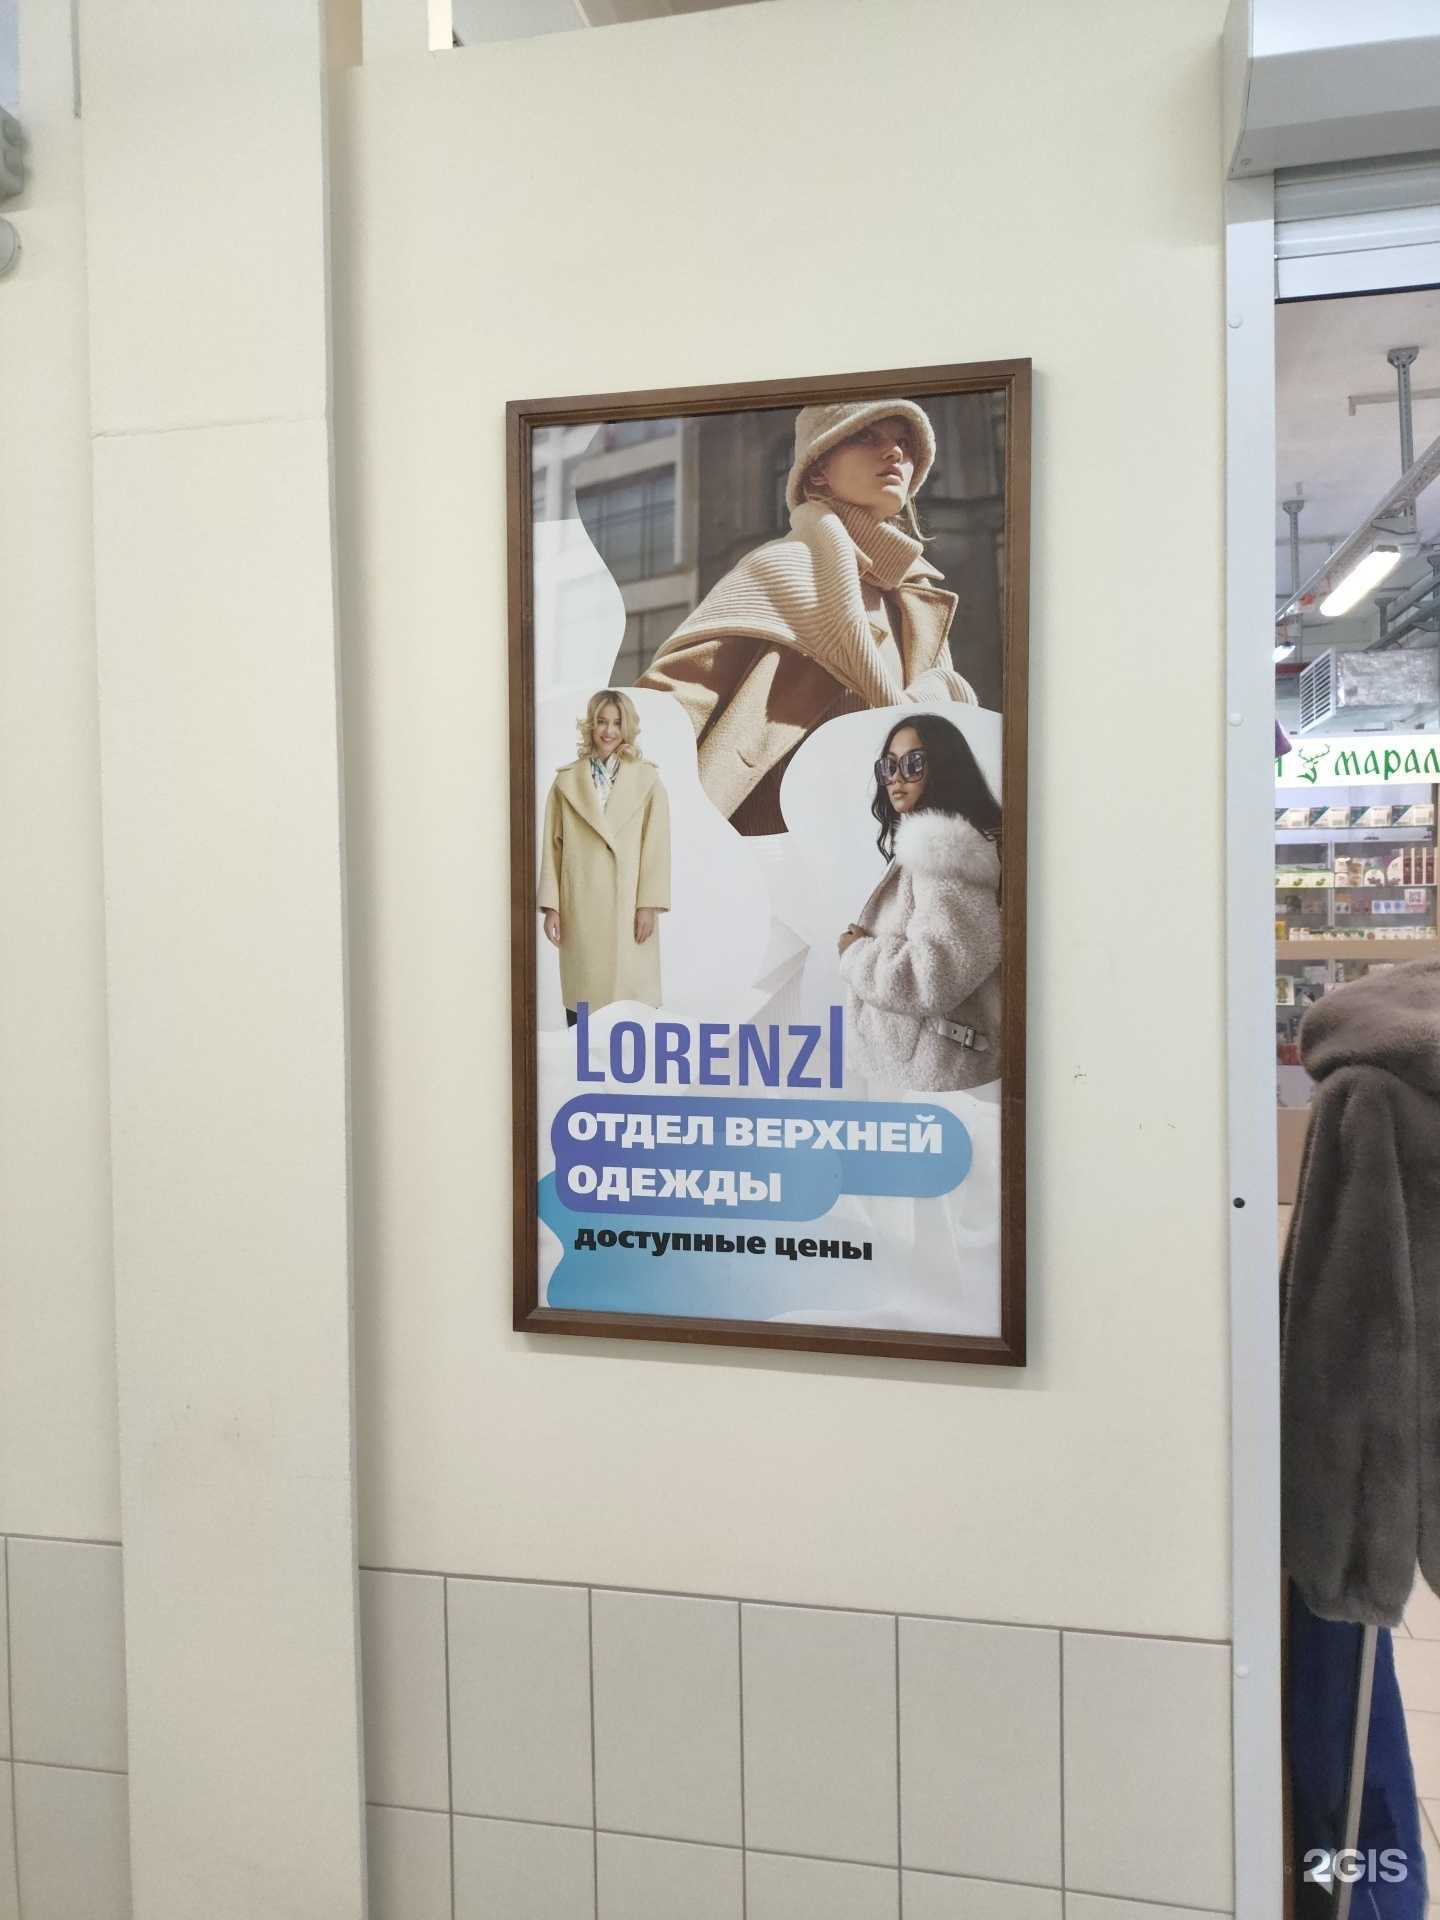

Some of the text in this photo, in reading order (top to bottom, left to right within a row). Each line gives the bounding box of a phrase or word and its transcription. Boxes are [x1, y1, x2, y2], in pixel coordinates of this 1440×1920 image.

[576, 1001, 843, 1089] LORENZI
[567, 1111, 943, 1154] ОТДЕЛ ВЕРХНЕЙ
[567, 1164, 781, 1206] ОДЕЖДЫ
[574, 1228, 873, 1261] доступные цены
